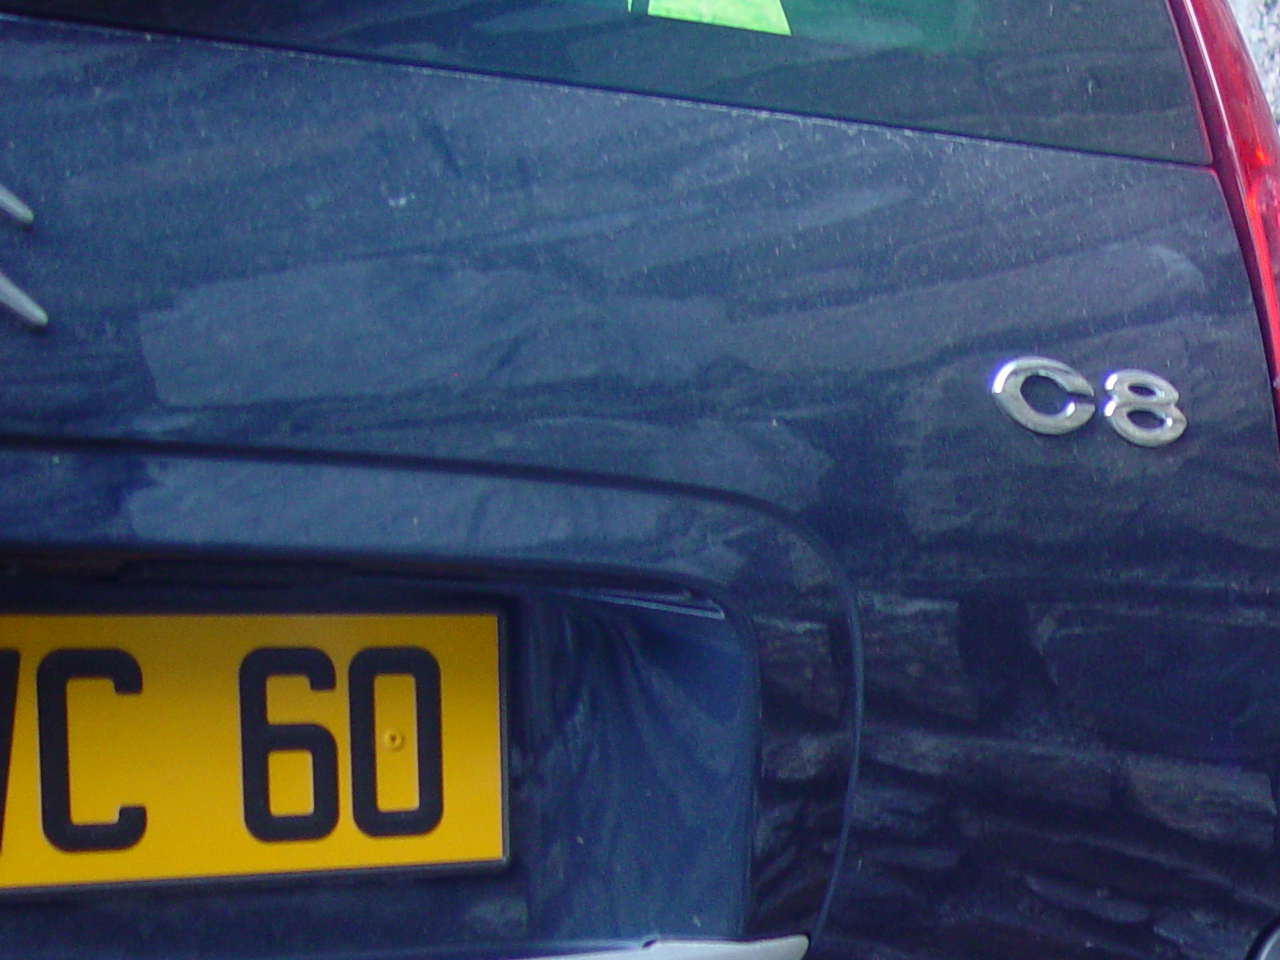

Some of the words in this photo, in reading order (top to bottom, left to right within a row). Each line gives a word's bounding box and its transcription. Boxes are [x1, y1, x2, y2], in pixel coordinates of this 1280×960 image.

[991, 356, 1188, 448] C8
[0, 646, 148, 856] C
[238, 645, 444, 843] 60
